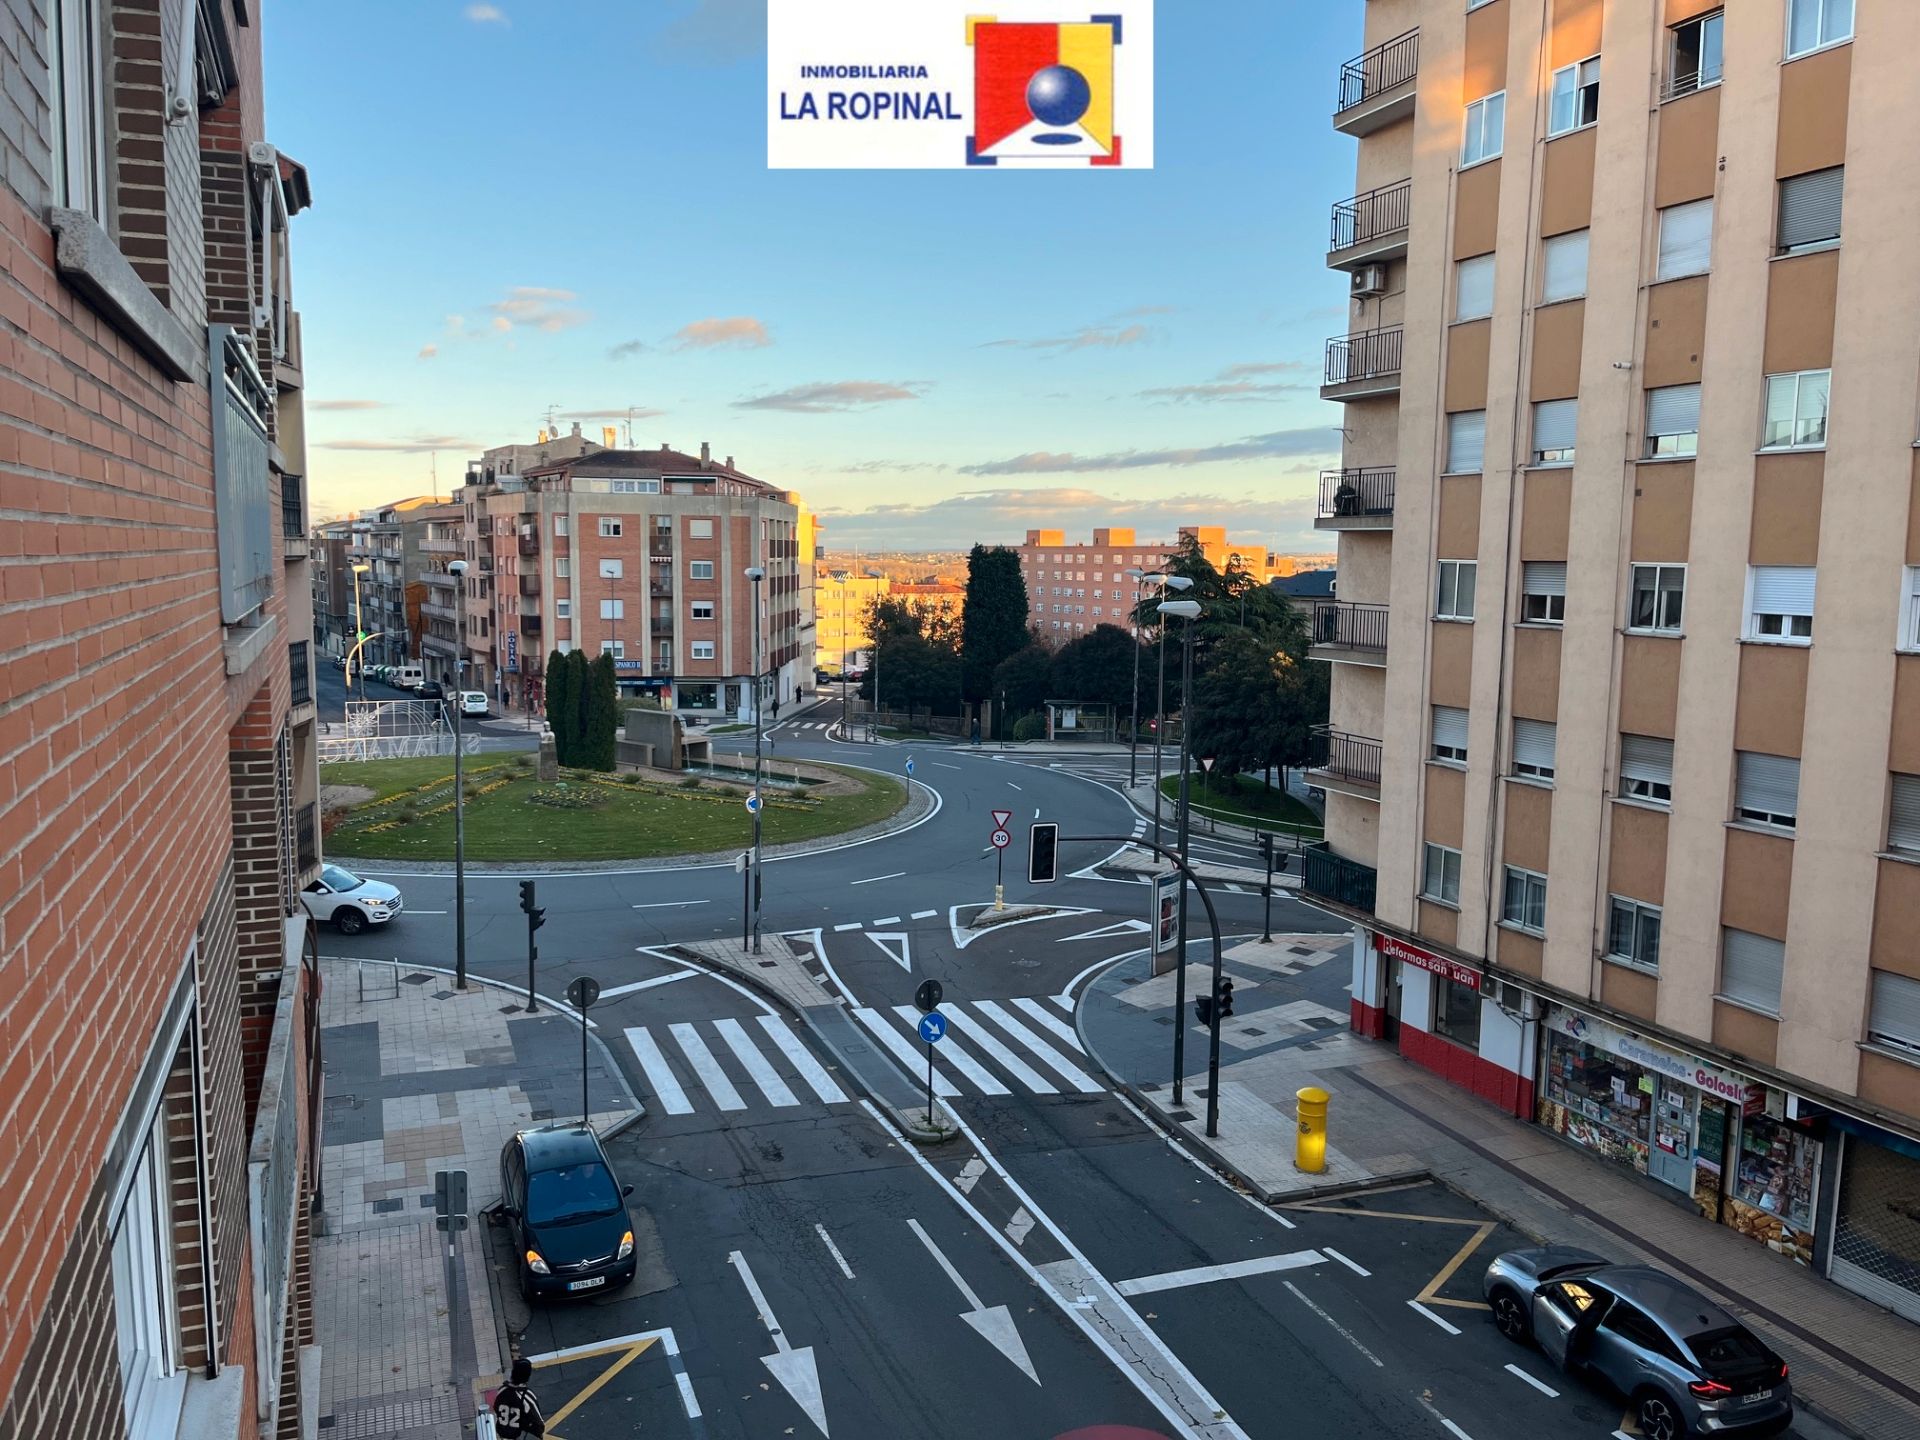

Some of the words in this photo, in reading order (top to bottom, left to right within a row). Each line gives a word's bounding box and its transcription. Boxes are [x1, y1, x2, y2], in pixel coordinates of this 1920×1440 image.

[508, 631, 516, 666] HOSTAL
[995, 834, 1007, 842] 30
[1383, 937, 1427, 967] Reformas
[1427, 960, 1447, 975] san
[1448, 962, 1474, 986] uan
[1619, 1038, 1686, 1078] Caramelos
[498, 1404, 520, 1428] 32
